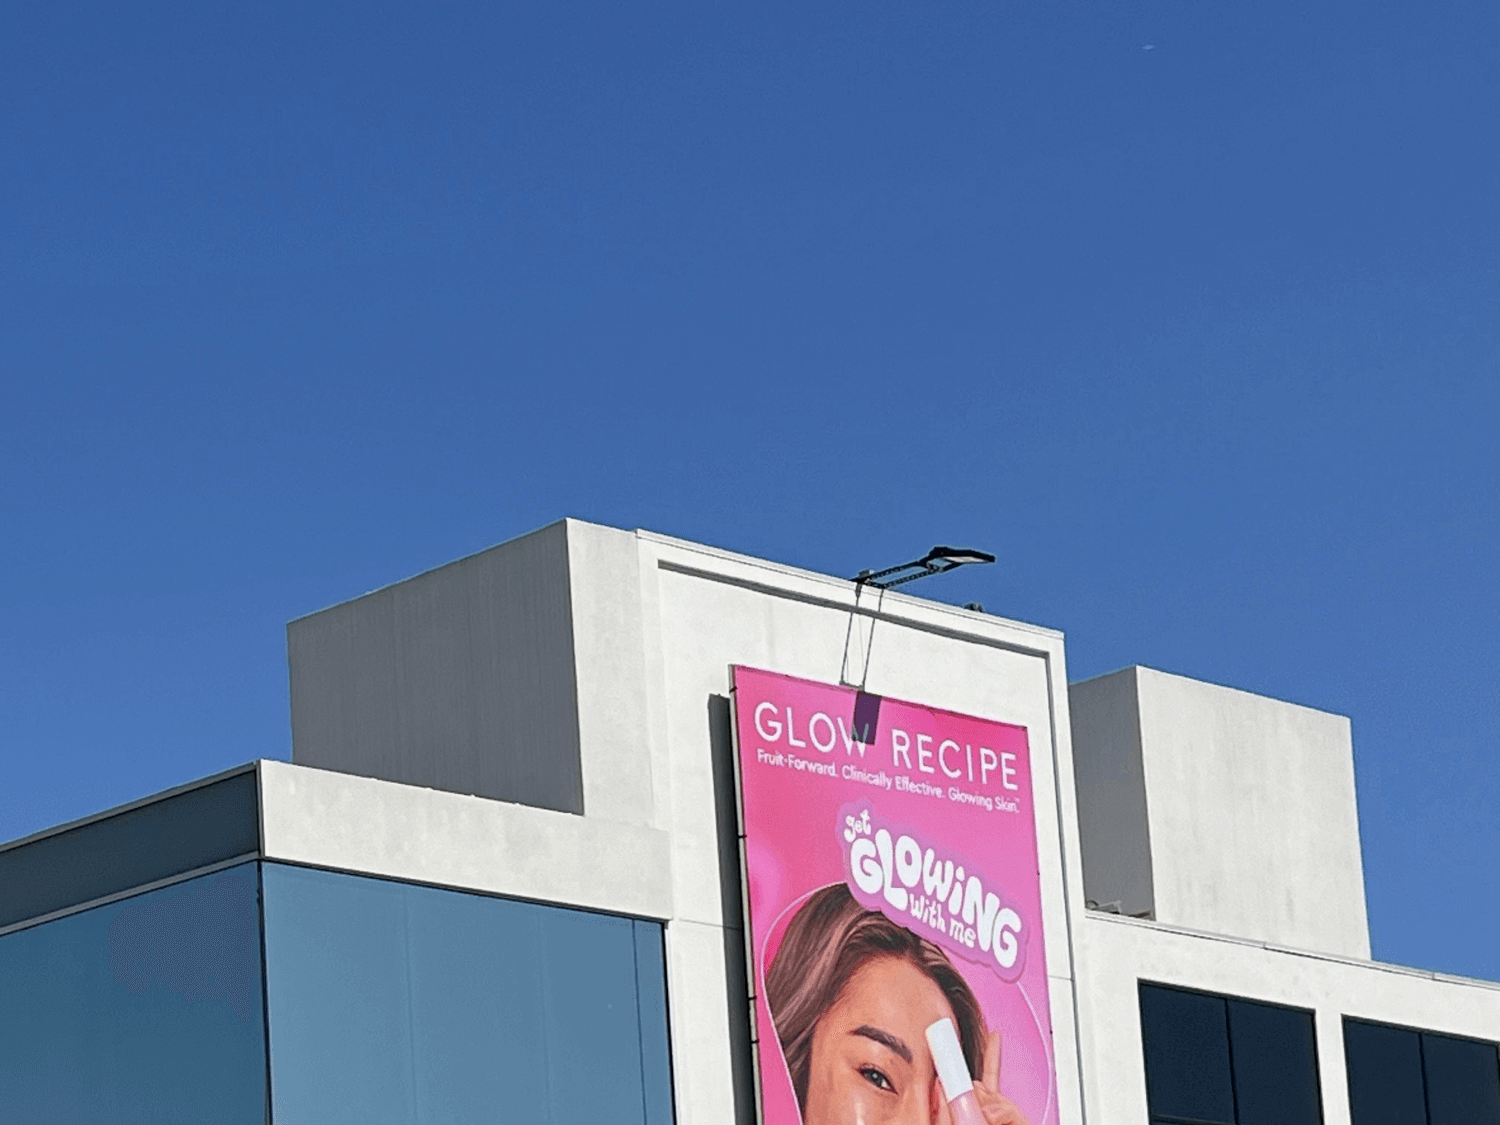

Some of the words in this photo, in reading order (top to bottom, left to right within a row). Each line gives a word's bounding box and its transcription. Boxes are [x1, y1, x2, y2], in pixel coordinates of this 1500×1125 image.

[754, 702, 869, 757] GLOW
[891, 729, 1018, 790] RECIPE
[842, 765, 893, 790] Clinically
[948, 786, 993, 811] Glowing
[843, 809, 872, 842] get
[909, 894, 946, 934] with
[949, 918, 976, 948] me
